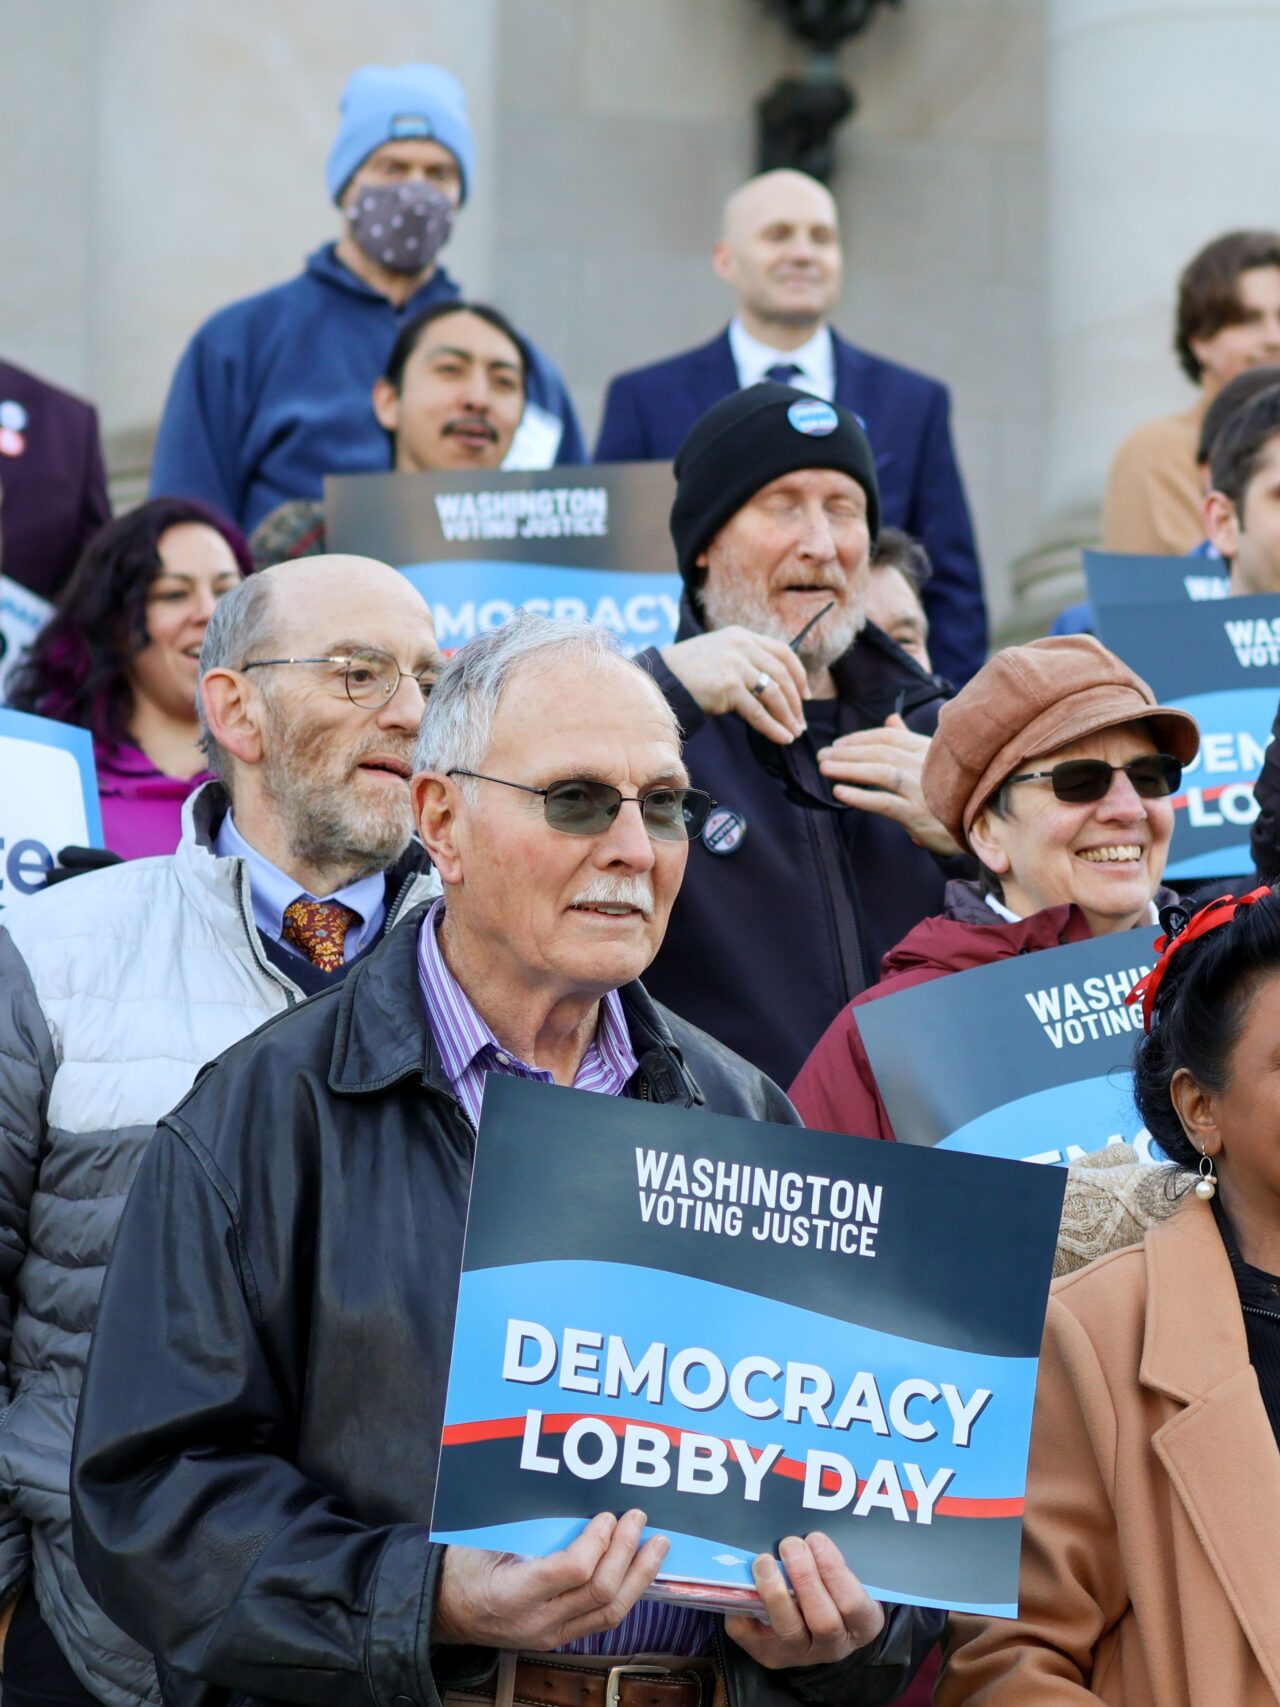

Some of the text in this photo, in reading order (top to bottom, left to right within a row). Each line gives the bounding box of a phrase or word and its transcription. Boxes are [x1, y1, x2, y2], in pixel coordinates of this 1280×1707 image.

[435, 487, 608, 523] WASHINGTON
[441, 515, 609, 541] VOTING JUSTICE
[634, 1147, 883, 1225] WASHINGTON
[638, 1190, 878, 1257] VOTING JUSTICE
[502, 1317, 992, 1449] DEMOCRACY
[519, 1408, 955, 1526] LOBBY DAY
